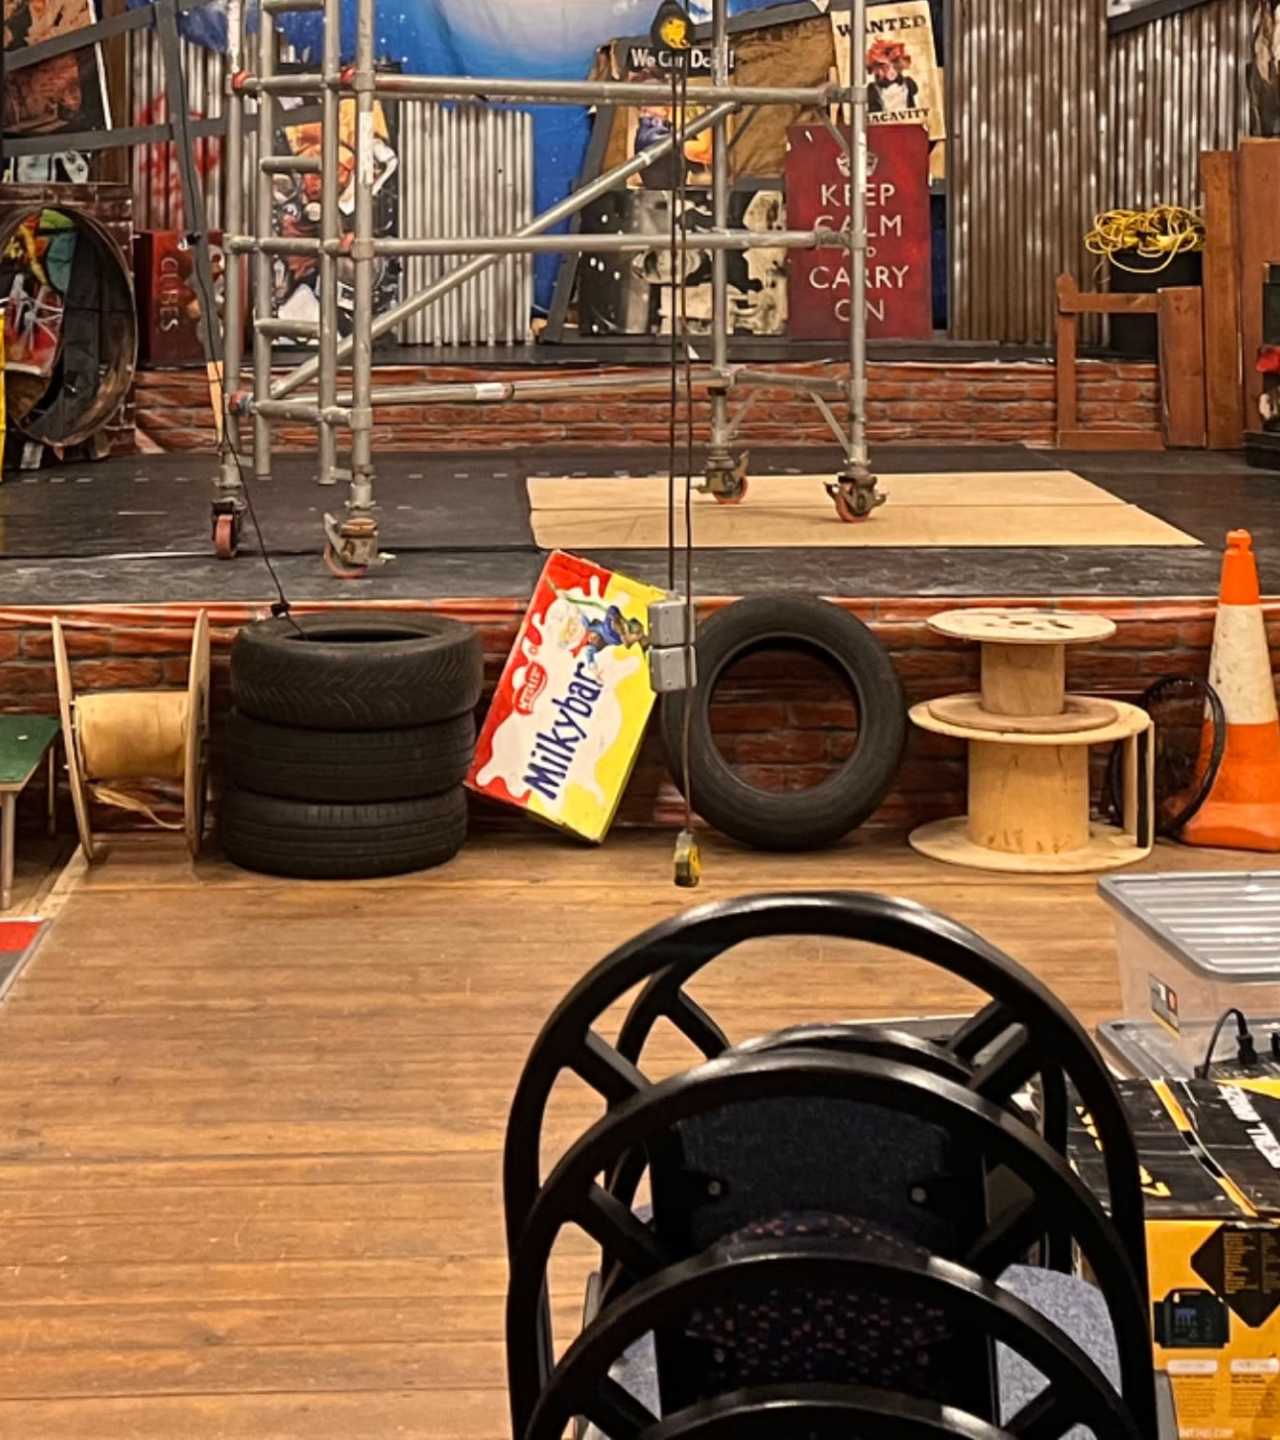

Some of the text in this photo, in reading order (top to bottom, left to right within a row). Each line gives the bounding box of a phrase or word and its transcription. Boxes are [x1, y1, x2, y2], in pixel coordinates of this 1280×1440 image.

[836, 14, 927, 38] WNTED
[866, 107, 930, 124] ACAVITY
[522, 661, 605, 801] Milkybar
